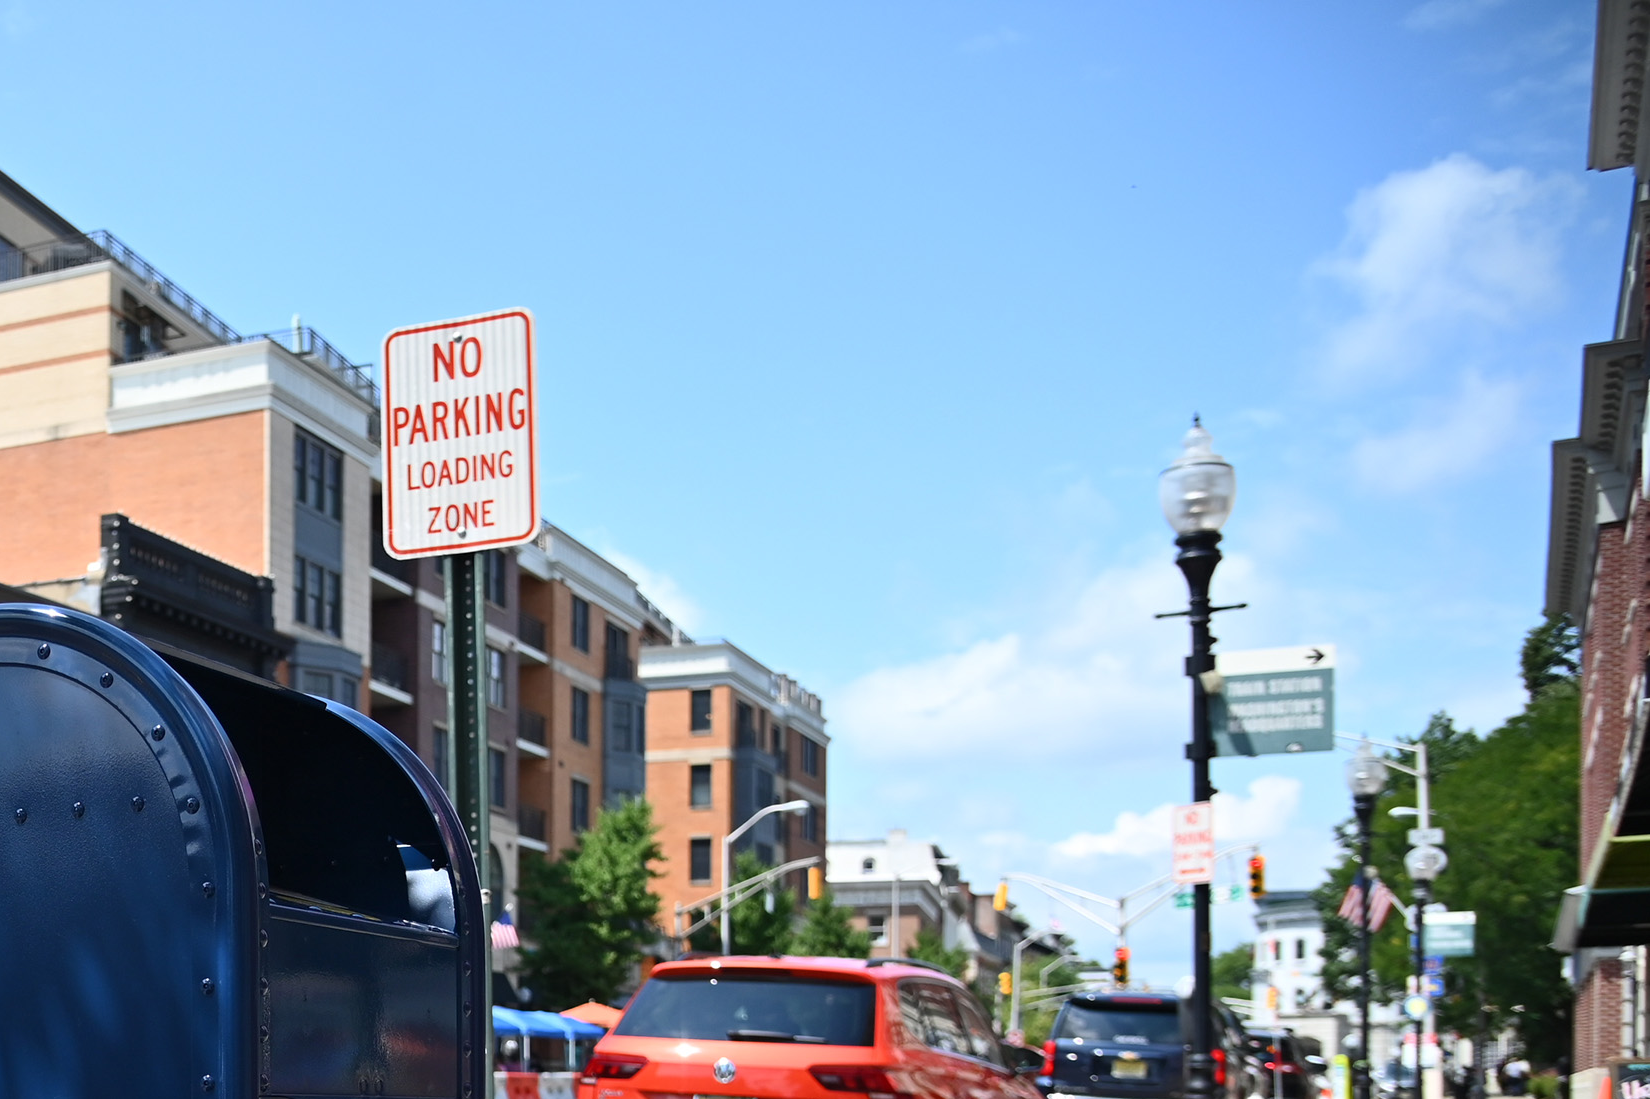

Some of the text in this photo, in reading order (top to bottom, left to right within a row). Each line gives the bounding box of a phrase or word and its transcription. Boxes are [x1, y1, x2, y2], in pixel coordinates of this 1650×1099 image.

[433, 336, 482, 382] NO
[393, 388, 526, 447] PARKING
[407, 450, 513, 490] LOADING
[427, 500, 495, 534] ZONE
